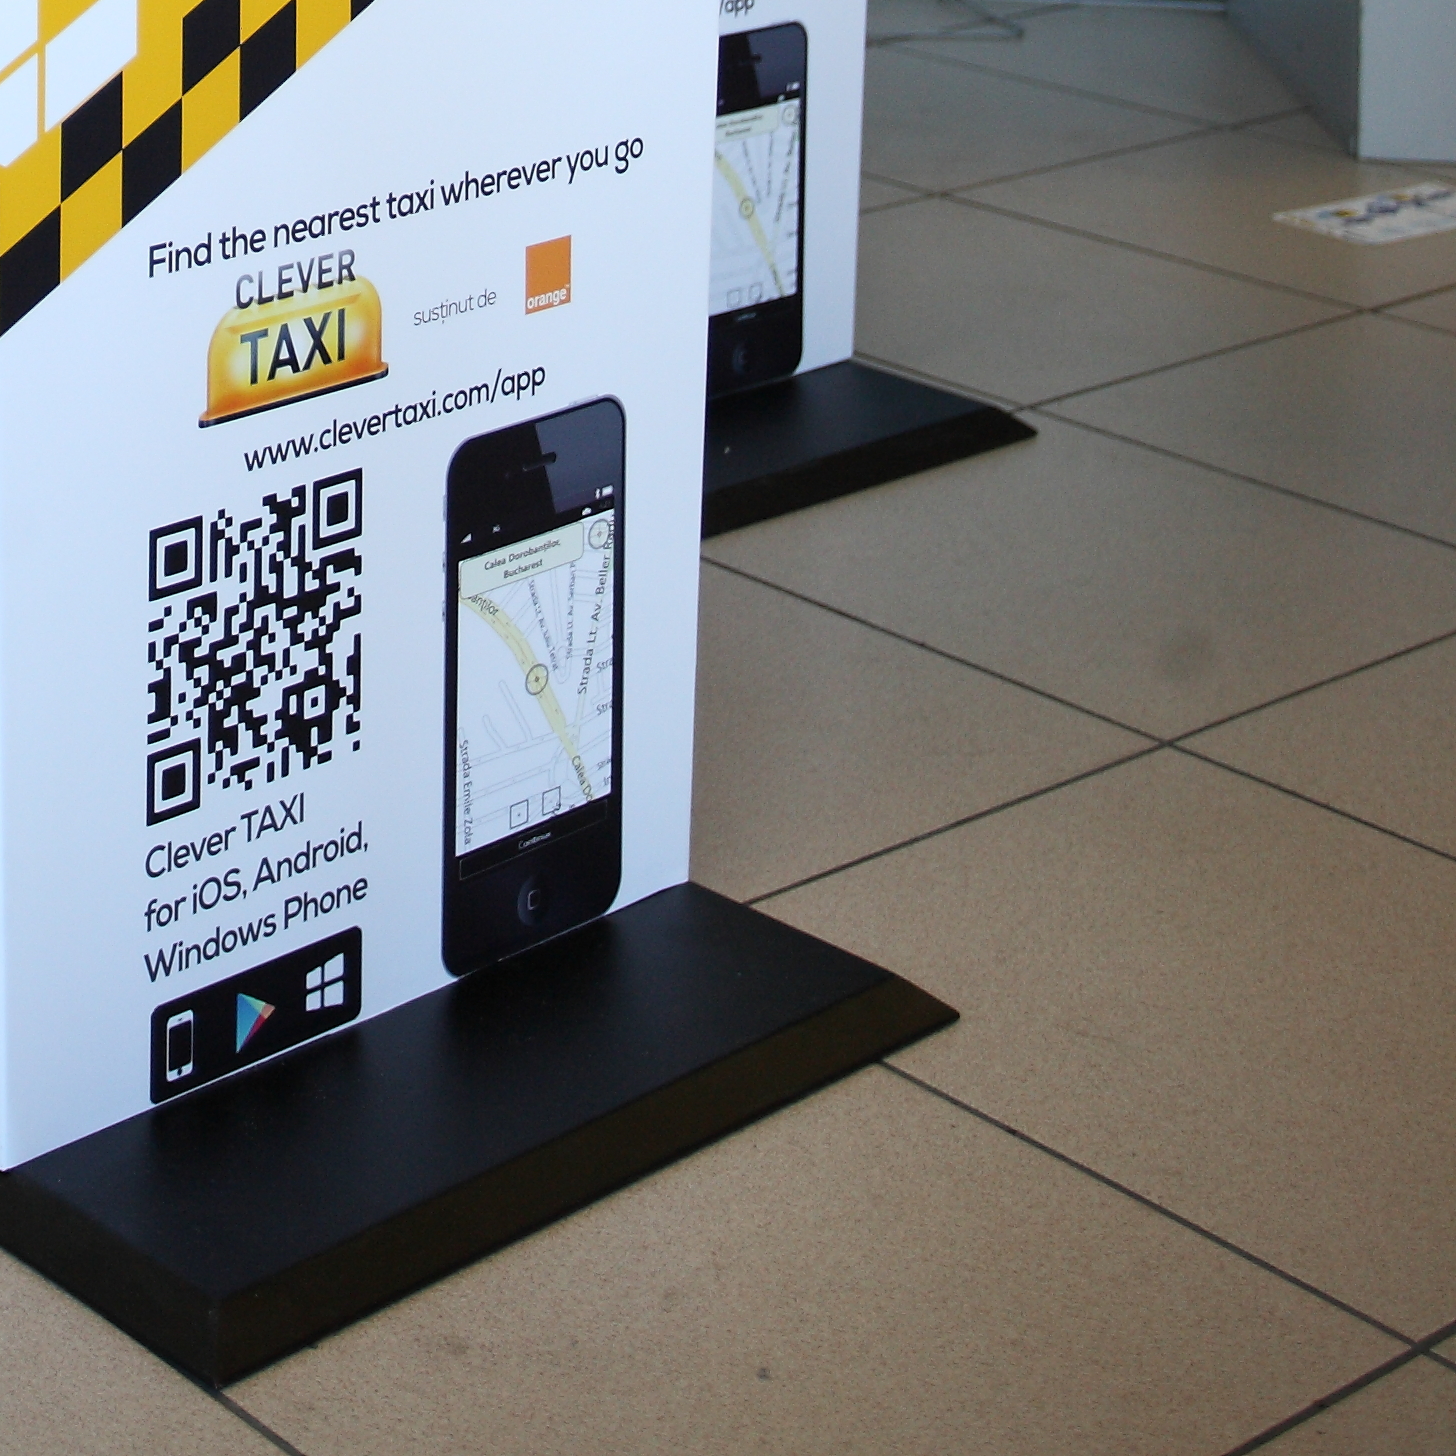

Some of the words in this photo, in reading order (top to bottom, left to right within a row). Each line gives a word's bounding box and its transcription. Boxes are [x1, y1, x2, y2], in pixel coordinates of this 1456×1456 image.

[148, 231, 212, 279] Find
[218, 225, 267, 262] the
[273, 196, 381, 249] nearest
[386, 179, 435, 220] taxi
[440, 153, 562, 207] wherever
[565, 143, 610, 185] you
[615, 136, 645, 175] go
[234, 248, 356, 310] CLEVER
[477, 288, 497, 309] de
[526, 287, 567, 310] orange
[240, 308, 347, 387] TAXI
[243, 365, 546, 472] www.clevertaxi.com/app
[595, 555, 611, 595] Beller
[592, 599, 604, 622] Av.
[577, 647, 594, 695] Strada
[458, 739, 471, 779] Strada
[571, 755, 587, 787] Calea
[463, 780, 474, 815] Emile
[145, 825, 237, 878] Clever
[240, 792, 305, 843] TAXI
[464, 816, 474, 845] Zola
[144, 895, 187, 932] for
[192, 867, 247, 915] iOS,
[252, 820, 369, 892] Android,
[143, 912, 277, 983] Windows
[284, 876, 368, 930] Phone
